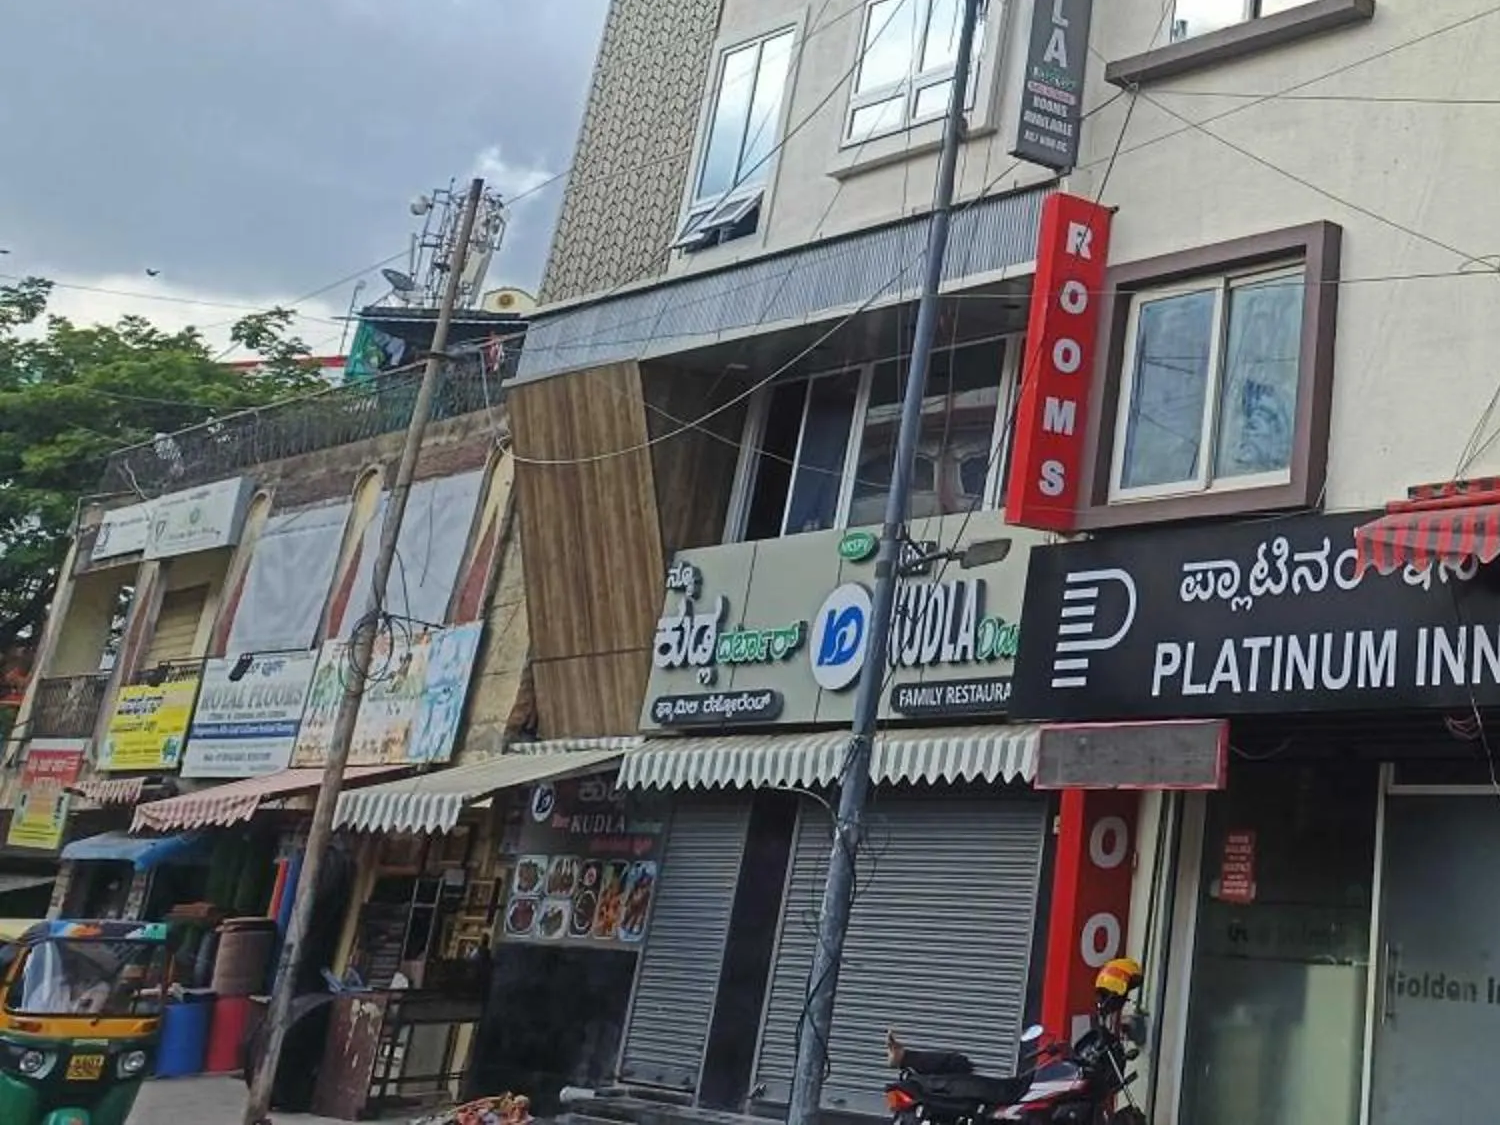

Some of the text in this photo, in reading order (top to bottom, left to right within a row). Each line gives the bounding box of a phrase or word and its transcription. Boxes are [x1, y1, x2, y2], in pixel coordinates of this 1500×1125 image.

[1039, 221, 1094, 497] ROOMS
[655, 594, 722, 684] ಕುಡ್ಲ
[1151, 629, 1397, 698] PLATINUM
[900, 686, 944, 708] FAMILY
[570, 813, 626, 835] KUDLA
